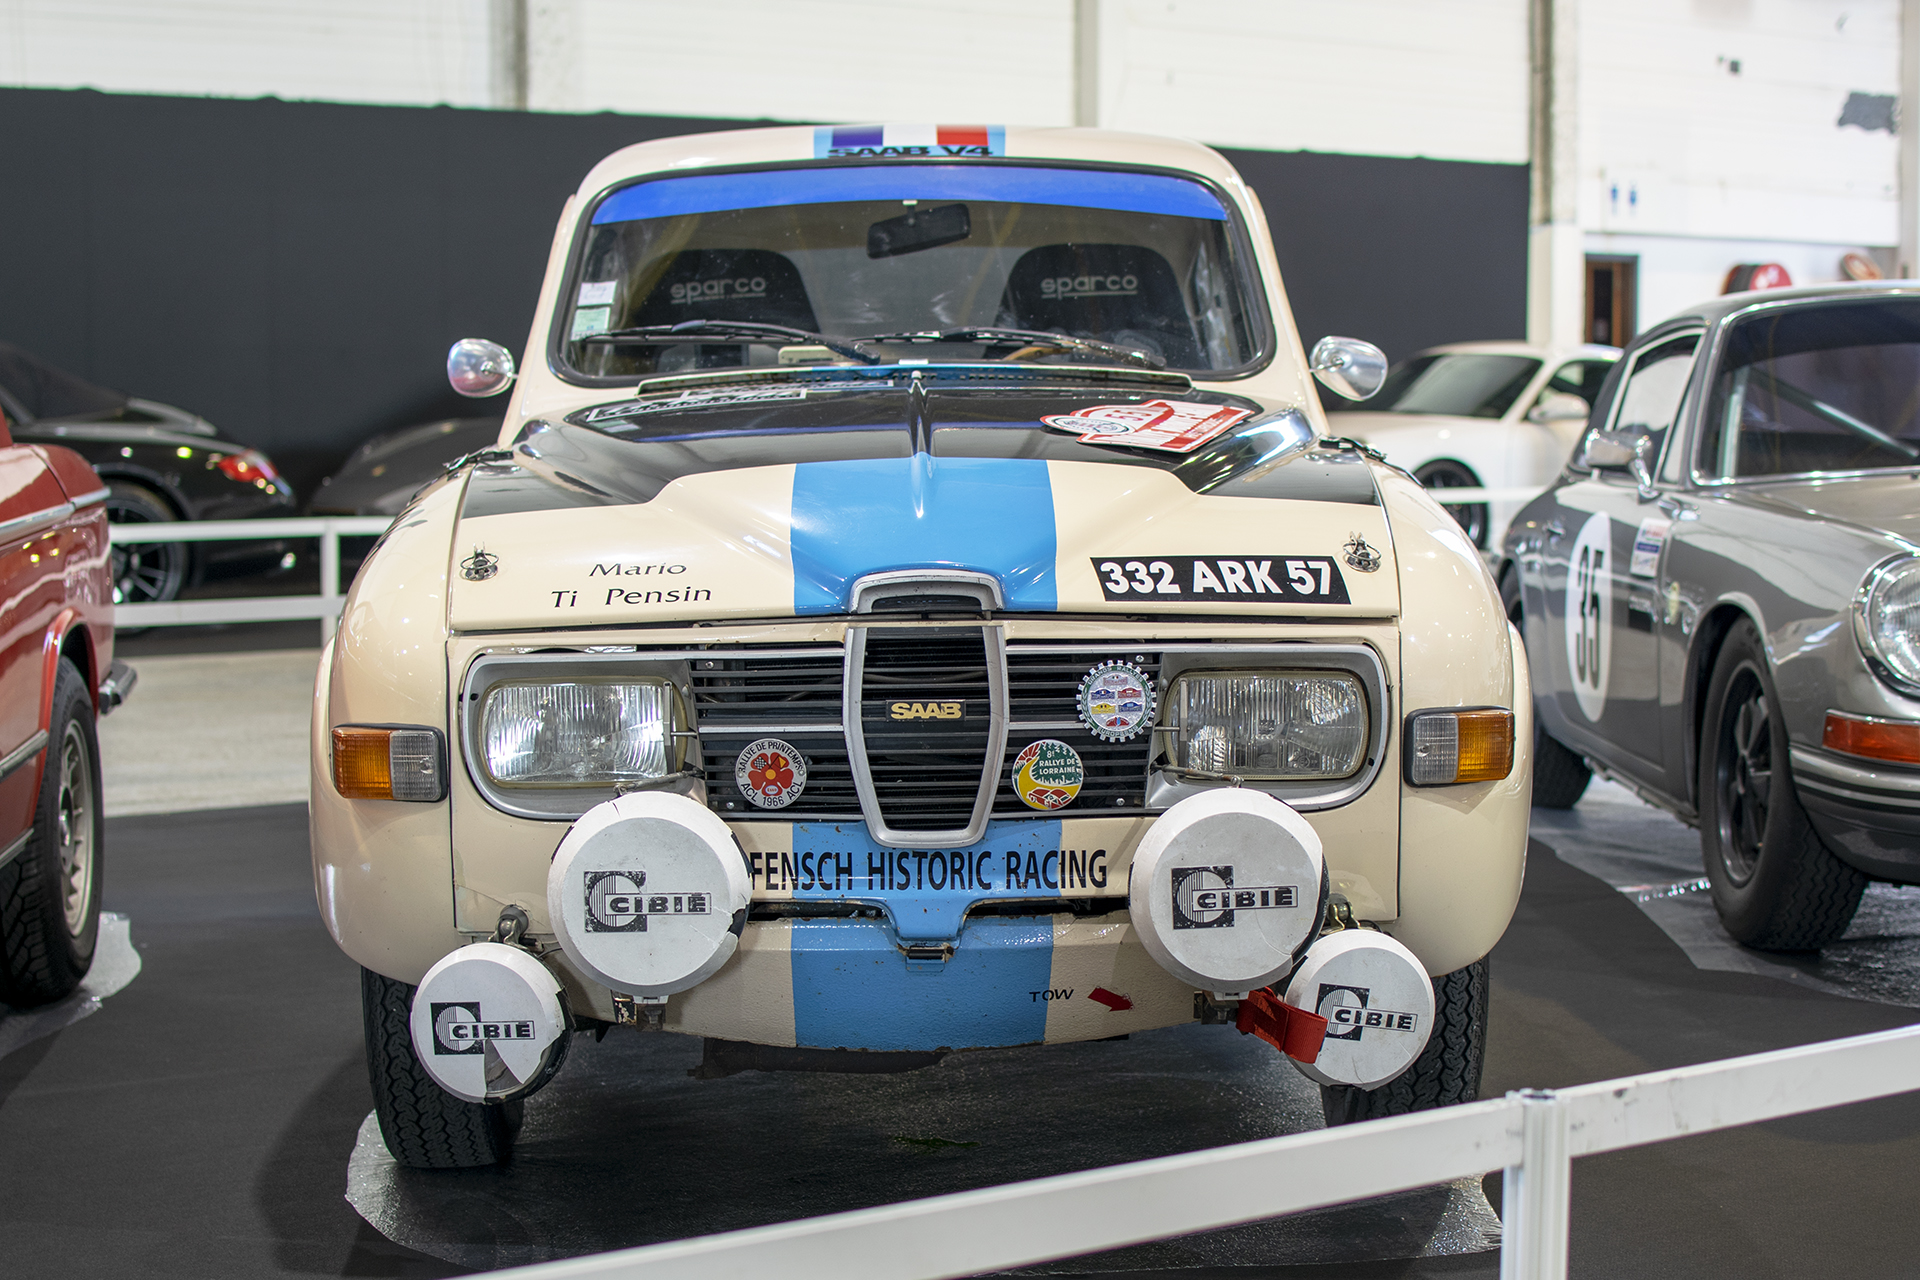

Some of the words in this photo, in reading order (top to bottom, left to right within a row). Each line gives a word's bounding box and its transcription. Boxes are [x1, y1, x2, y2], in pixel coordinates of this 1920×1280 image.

[828, 146, 930, 158] SAAB
[940, 145, 993, 157] V4
[671, 277, 766, 304] sparco
[1041, 275, 1138, 299] sparco
[588, 562, 687, 577] Mario
[1100, 561, 1181, 594] 332
[1193, 560, 1283, 594] ARK
[1285, 560, 1331, 595] 57
[551, 590, 578, 608] Ti
[605, 586, 712, 606] Pensin
[1575, 544, 1605, 691] 35
[891, 702, 962, 720] SAAB
[738, 746, 757, 773] RALLYE
[755, 742, 767, 752] DE
[767, 741, 804, 771] PRINTEMPS
[1039, 759, 1065, 767] RALLYE
[1039, 766, 1076, 775] LORRAINE
[741, 782, 759, 802] ACL
[786, 781, 803, 800] ACL
[762, 796, 785, 807] 1966
[749, 851, 853, 891] FENSCH
[868, 850, 992, 891] HISTORIC
[1005, 849, 1107, 890] RACING
[1029, 989, 1075, 1002] TOW
